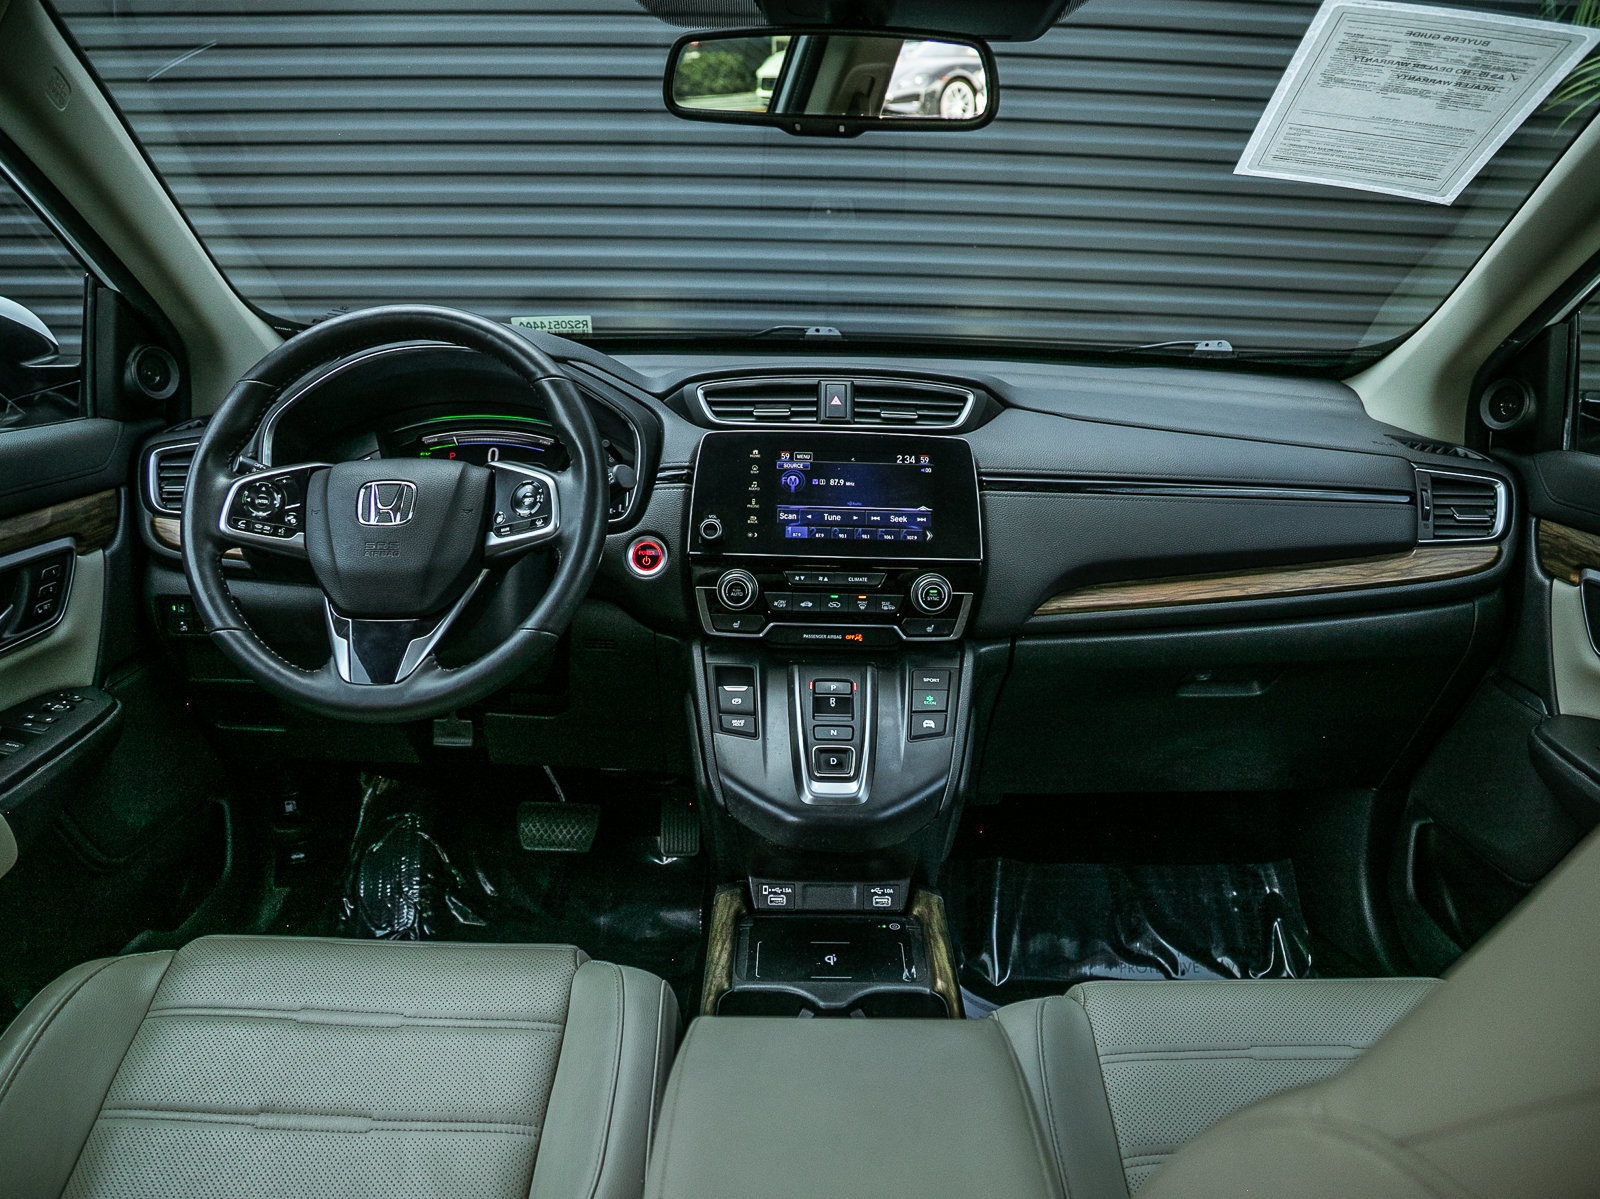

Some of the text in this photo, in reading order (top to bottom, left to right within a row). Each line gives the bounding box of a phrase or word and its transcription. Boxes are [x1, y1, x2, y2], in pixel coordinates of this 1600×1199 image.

[449, 452, 456, 460] P
[920, 456, 930, 464] 59
[779, 512, 797, 520] Scan
[823, 513, 842, 521] Tune
[889, 515, 908, 523] Seek
[830, 757, 837, 765] D
[1119, 962, 1200, 974] PROIVE
